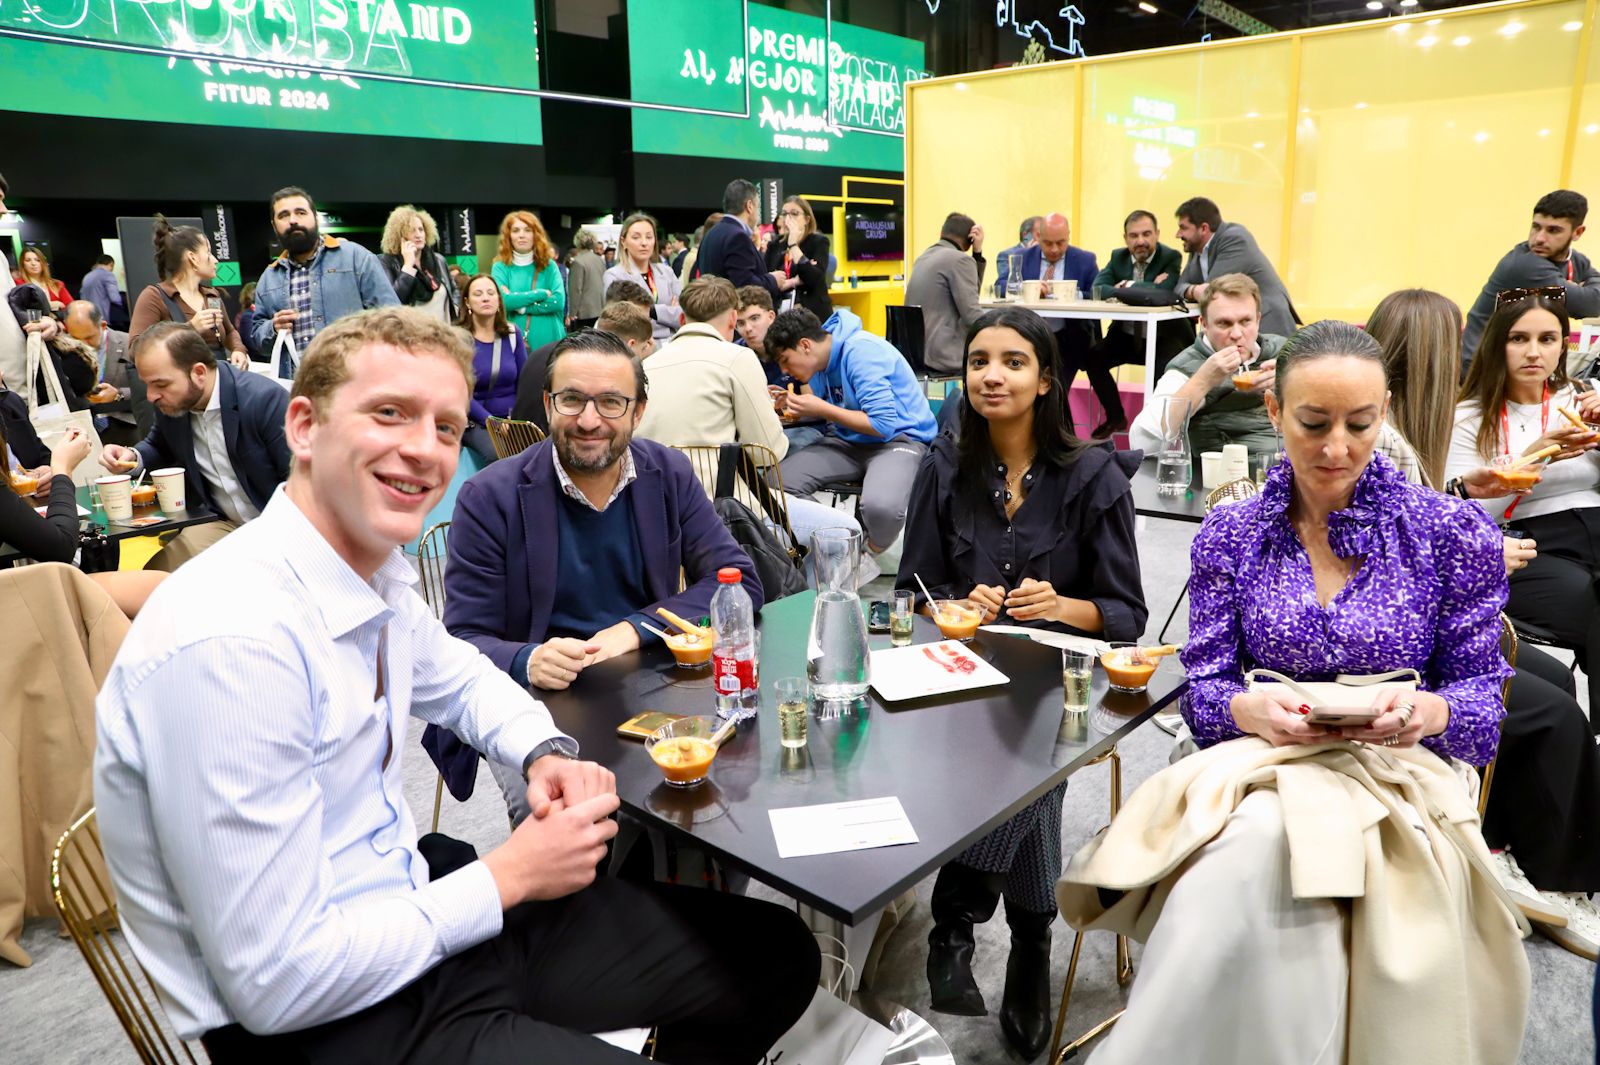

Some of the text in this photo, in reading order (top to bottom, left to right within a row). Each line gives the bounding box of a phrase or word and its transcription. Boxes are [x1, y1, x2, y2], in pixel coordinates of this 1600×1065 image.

[319, 0, 472, 45] STAND
[680, 48, 716, 86] AL
[750, 26, 844, 69] PREMIO
[204, 82, 330, 110] FITUR 2024
